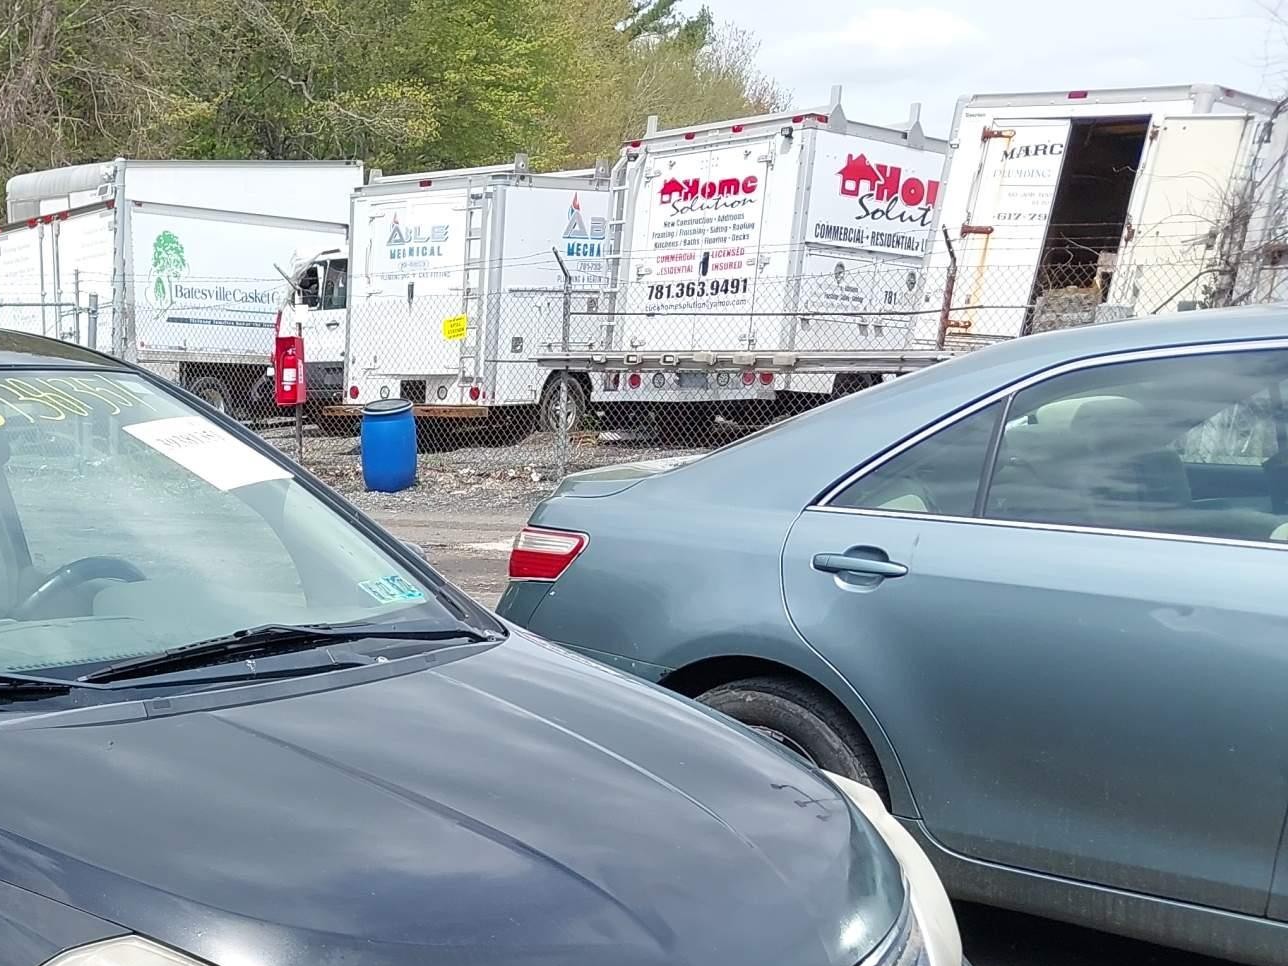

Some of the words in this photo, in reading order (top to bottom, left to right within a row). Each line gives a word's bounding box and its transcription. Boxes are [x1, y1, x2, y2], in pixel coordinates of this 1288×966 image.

[670, 196, 758, 216] Solution
[814, 223, 864, 244] COMMERCIAL
[870, 231, 915, 251] RESIDENTIAL
[711, 247, 745, 259] LICENSED
[656, 265, 694, 276] ESIDENTIAL
[711, 261, 743, 271] INSURED
[648, 278, 748, 300] 781.363.9491
